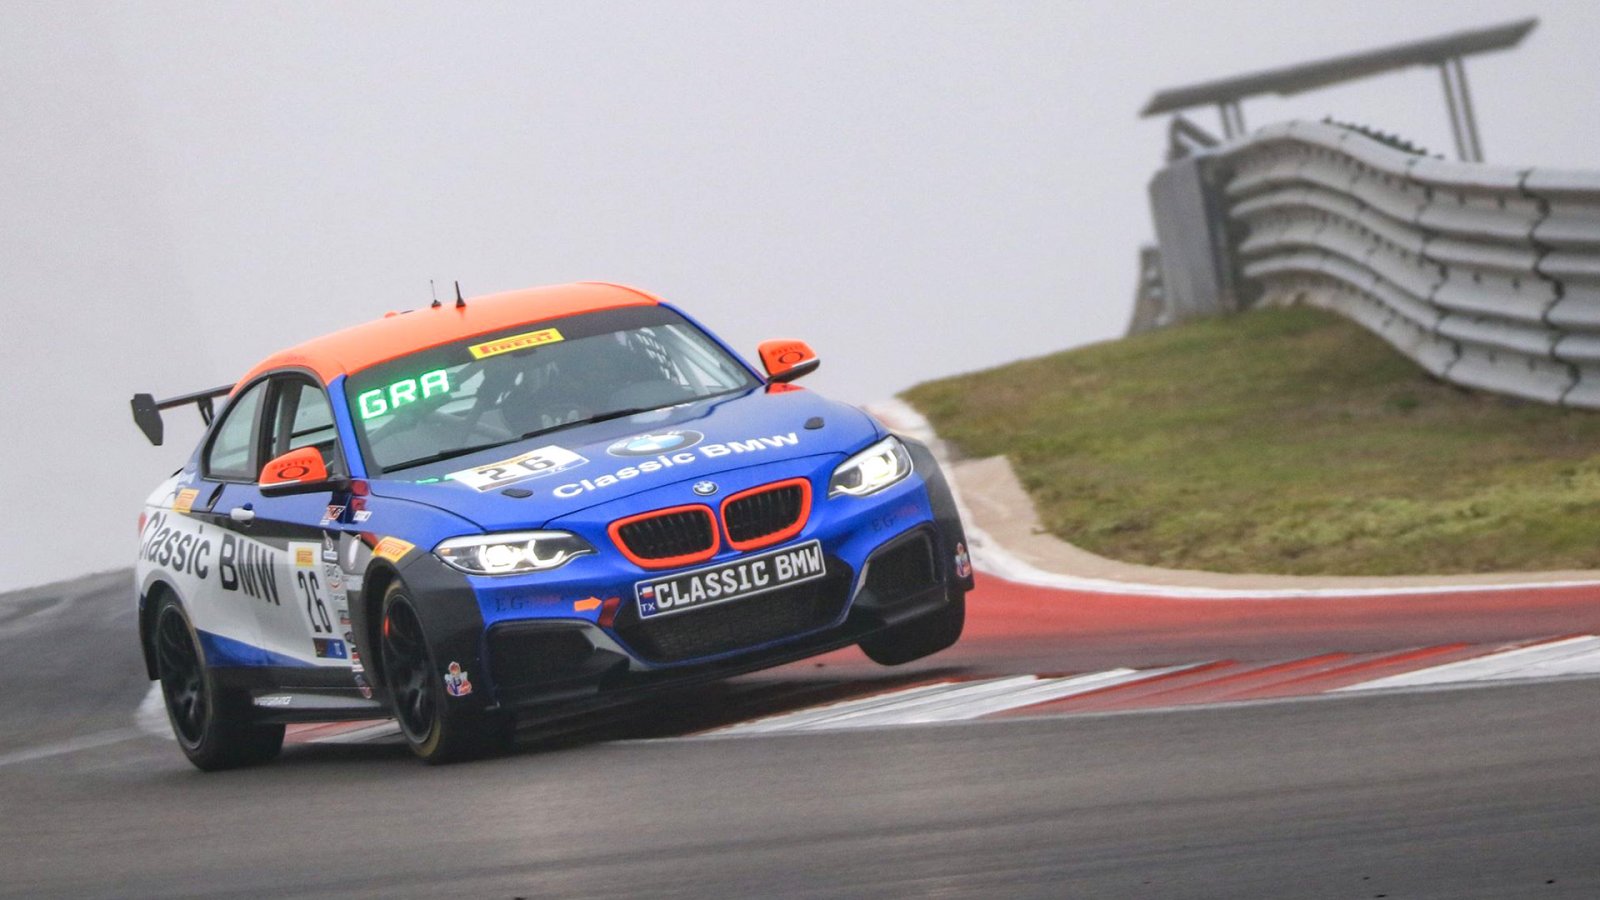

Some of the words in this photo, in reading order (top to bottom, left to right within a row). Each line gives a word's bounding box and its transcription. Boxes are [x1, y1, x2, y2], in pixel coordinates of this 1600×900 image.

[479, 331, 554, 354] PIRELLI
[359, 369, 450, 419] GRA
[478, 456, 556, 480] 26
[552, 452, 696, 497] Classic
[699, 432, 799, 459] BMW
[139, 511, 211, 579] Classic
[219, 533, 280, 606] BMW
[655, 561, 769, 609] CLASSIC
[775, 546, 821, 581] BMW
[297, 571, 333, 633] 26
[641, 602, 656, 612] TX
